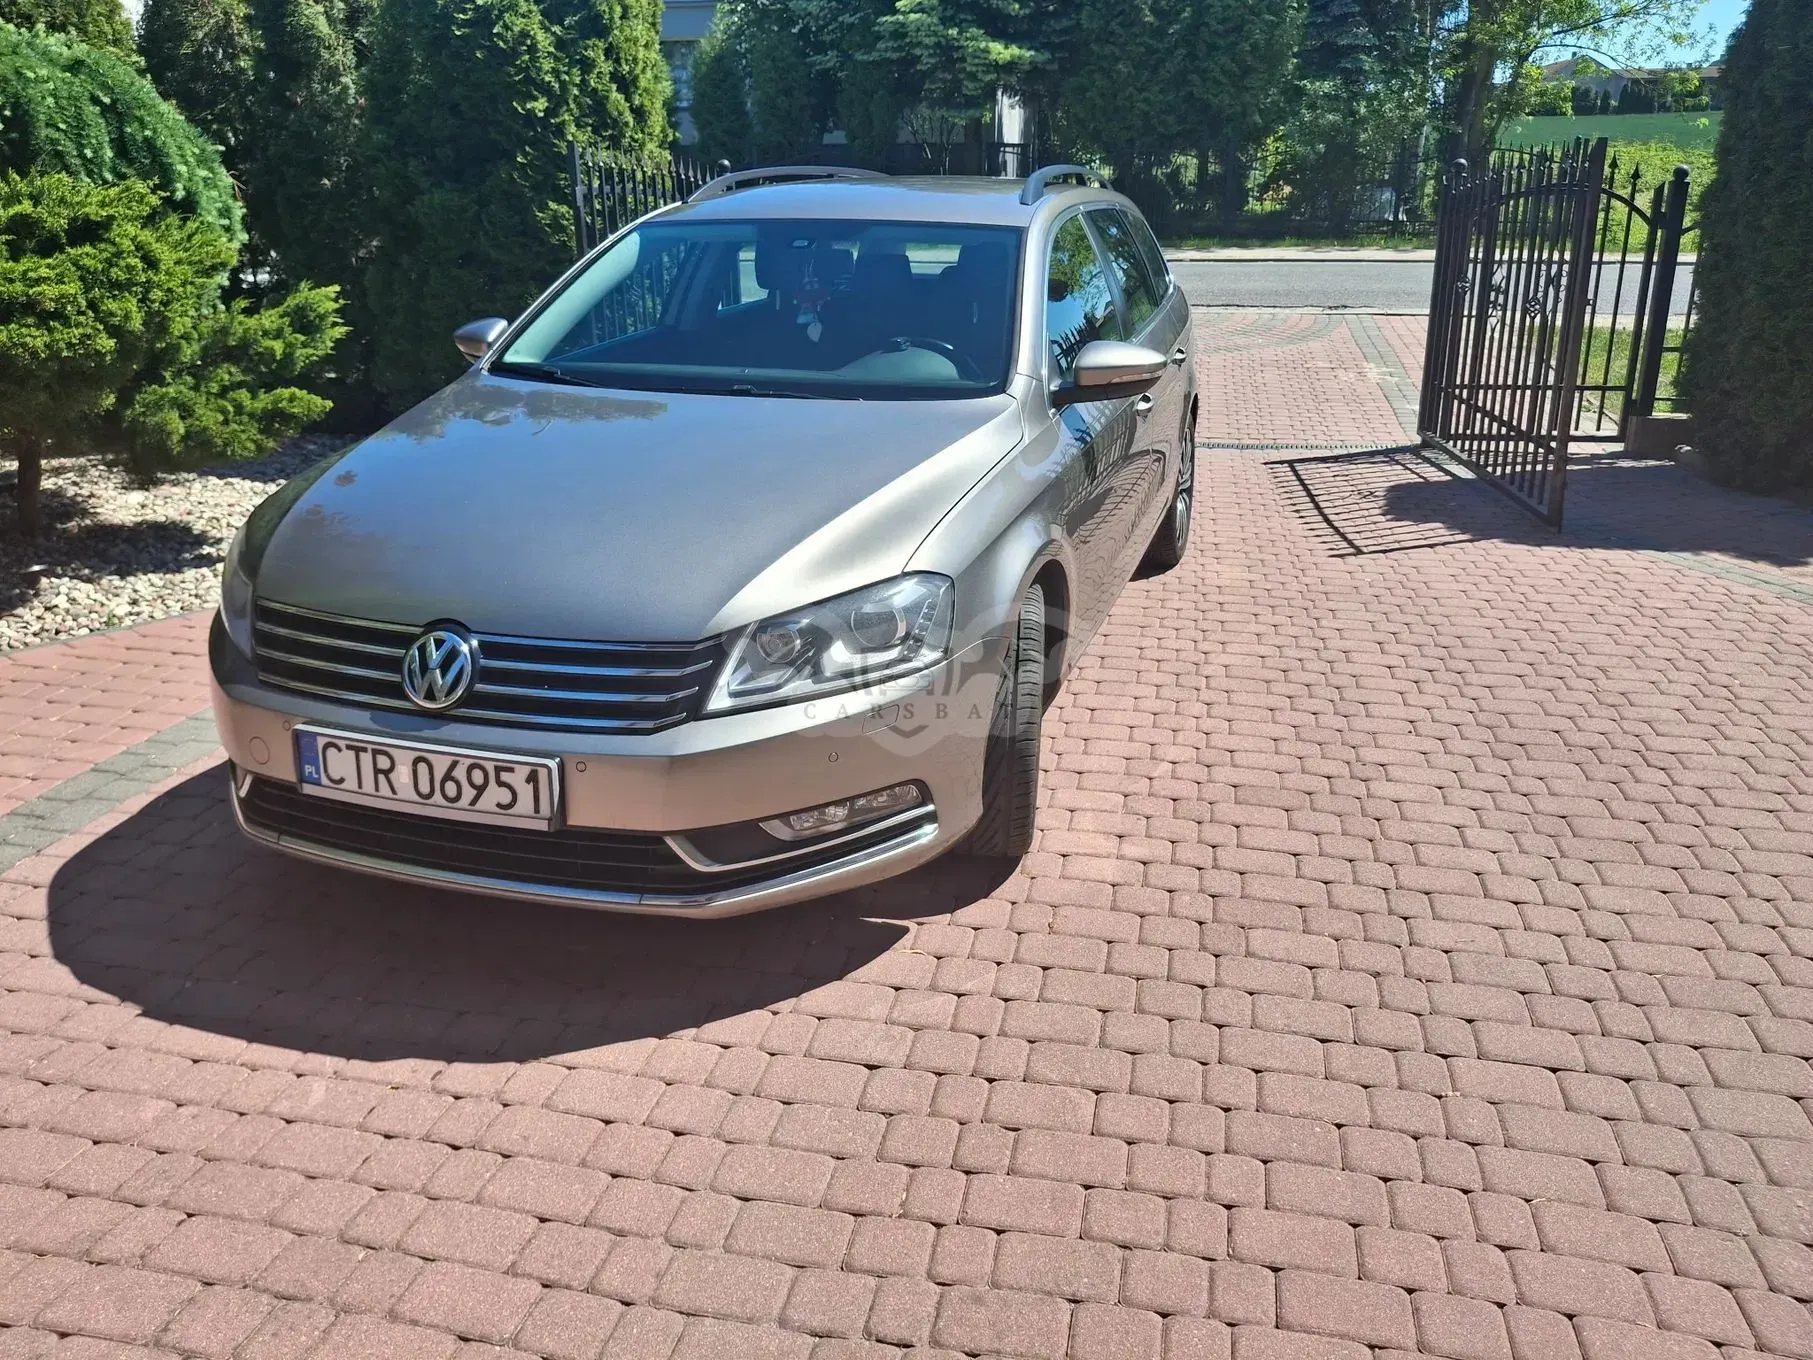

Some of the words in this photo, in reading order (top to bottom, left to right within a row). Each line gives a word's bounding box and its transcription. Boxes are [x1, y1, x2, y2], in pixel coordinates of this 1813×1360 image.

[403, 631, 472, 709] VW
[304, 764, 319, 779] PL
[321, 741, 398, 796] CTR
[411, 756, 541, 814] 06951
